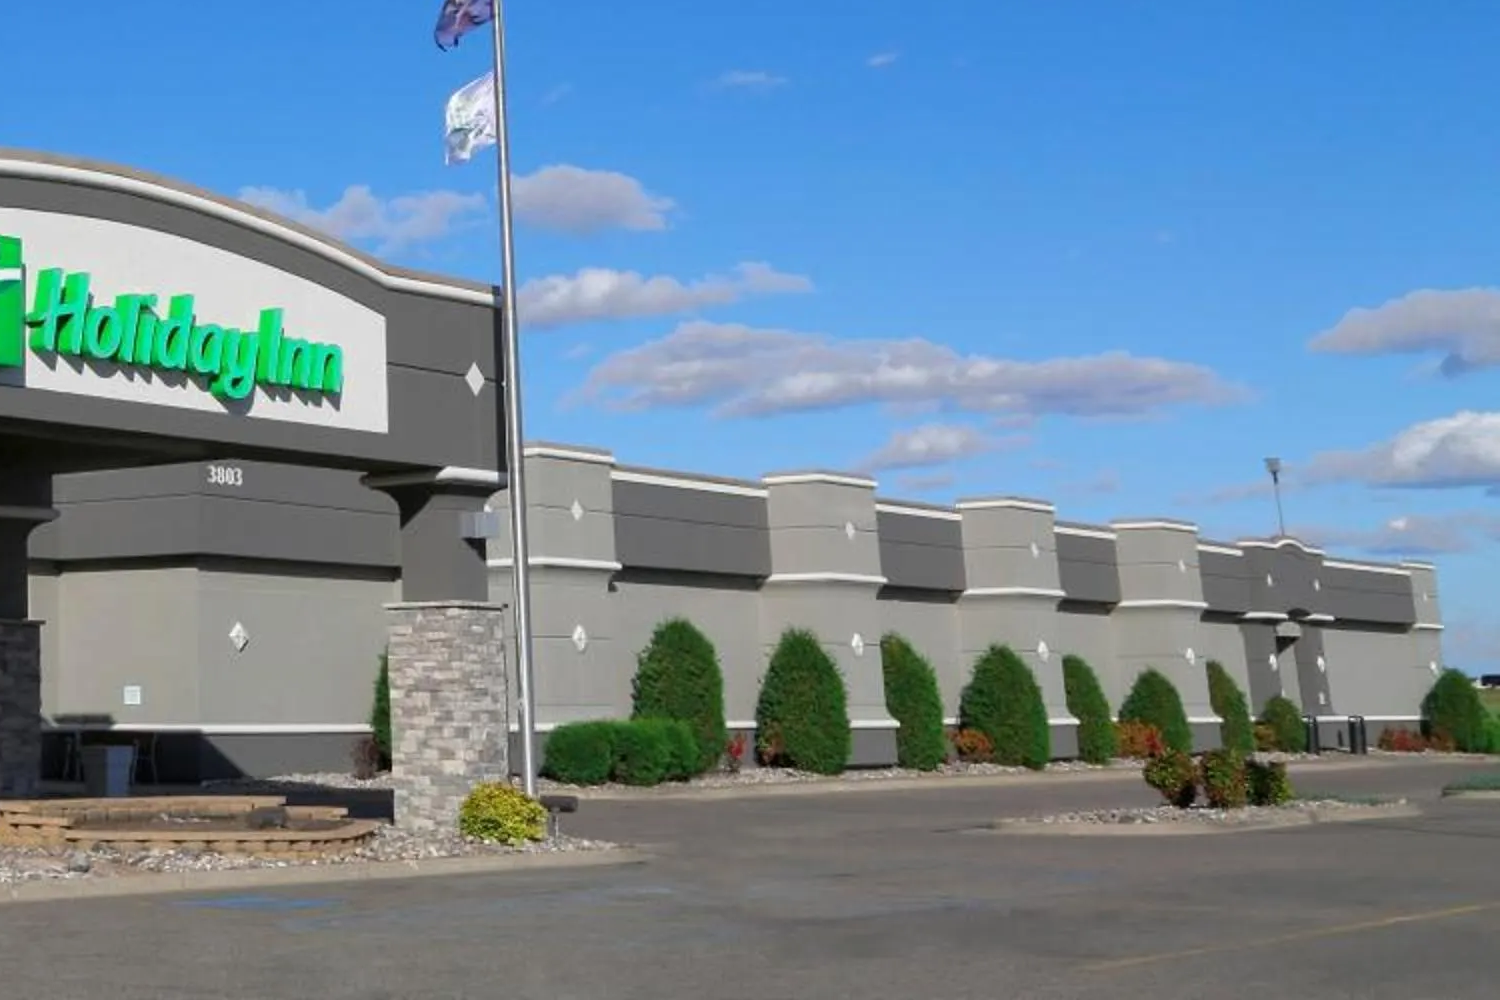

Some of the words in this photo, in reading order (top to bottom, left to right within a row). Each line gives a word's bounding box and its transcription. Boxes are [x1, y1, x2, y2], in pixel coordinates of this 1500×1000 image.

[26, 268, 256, 399] Holiday
[258, 308, 343, 393] Inn
[207, 465, 243, 486] 3803
